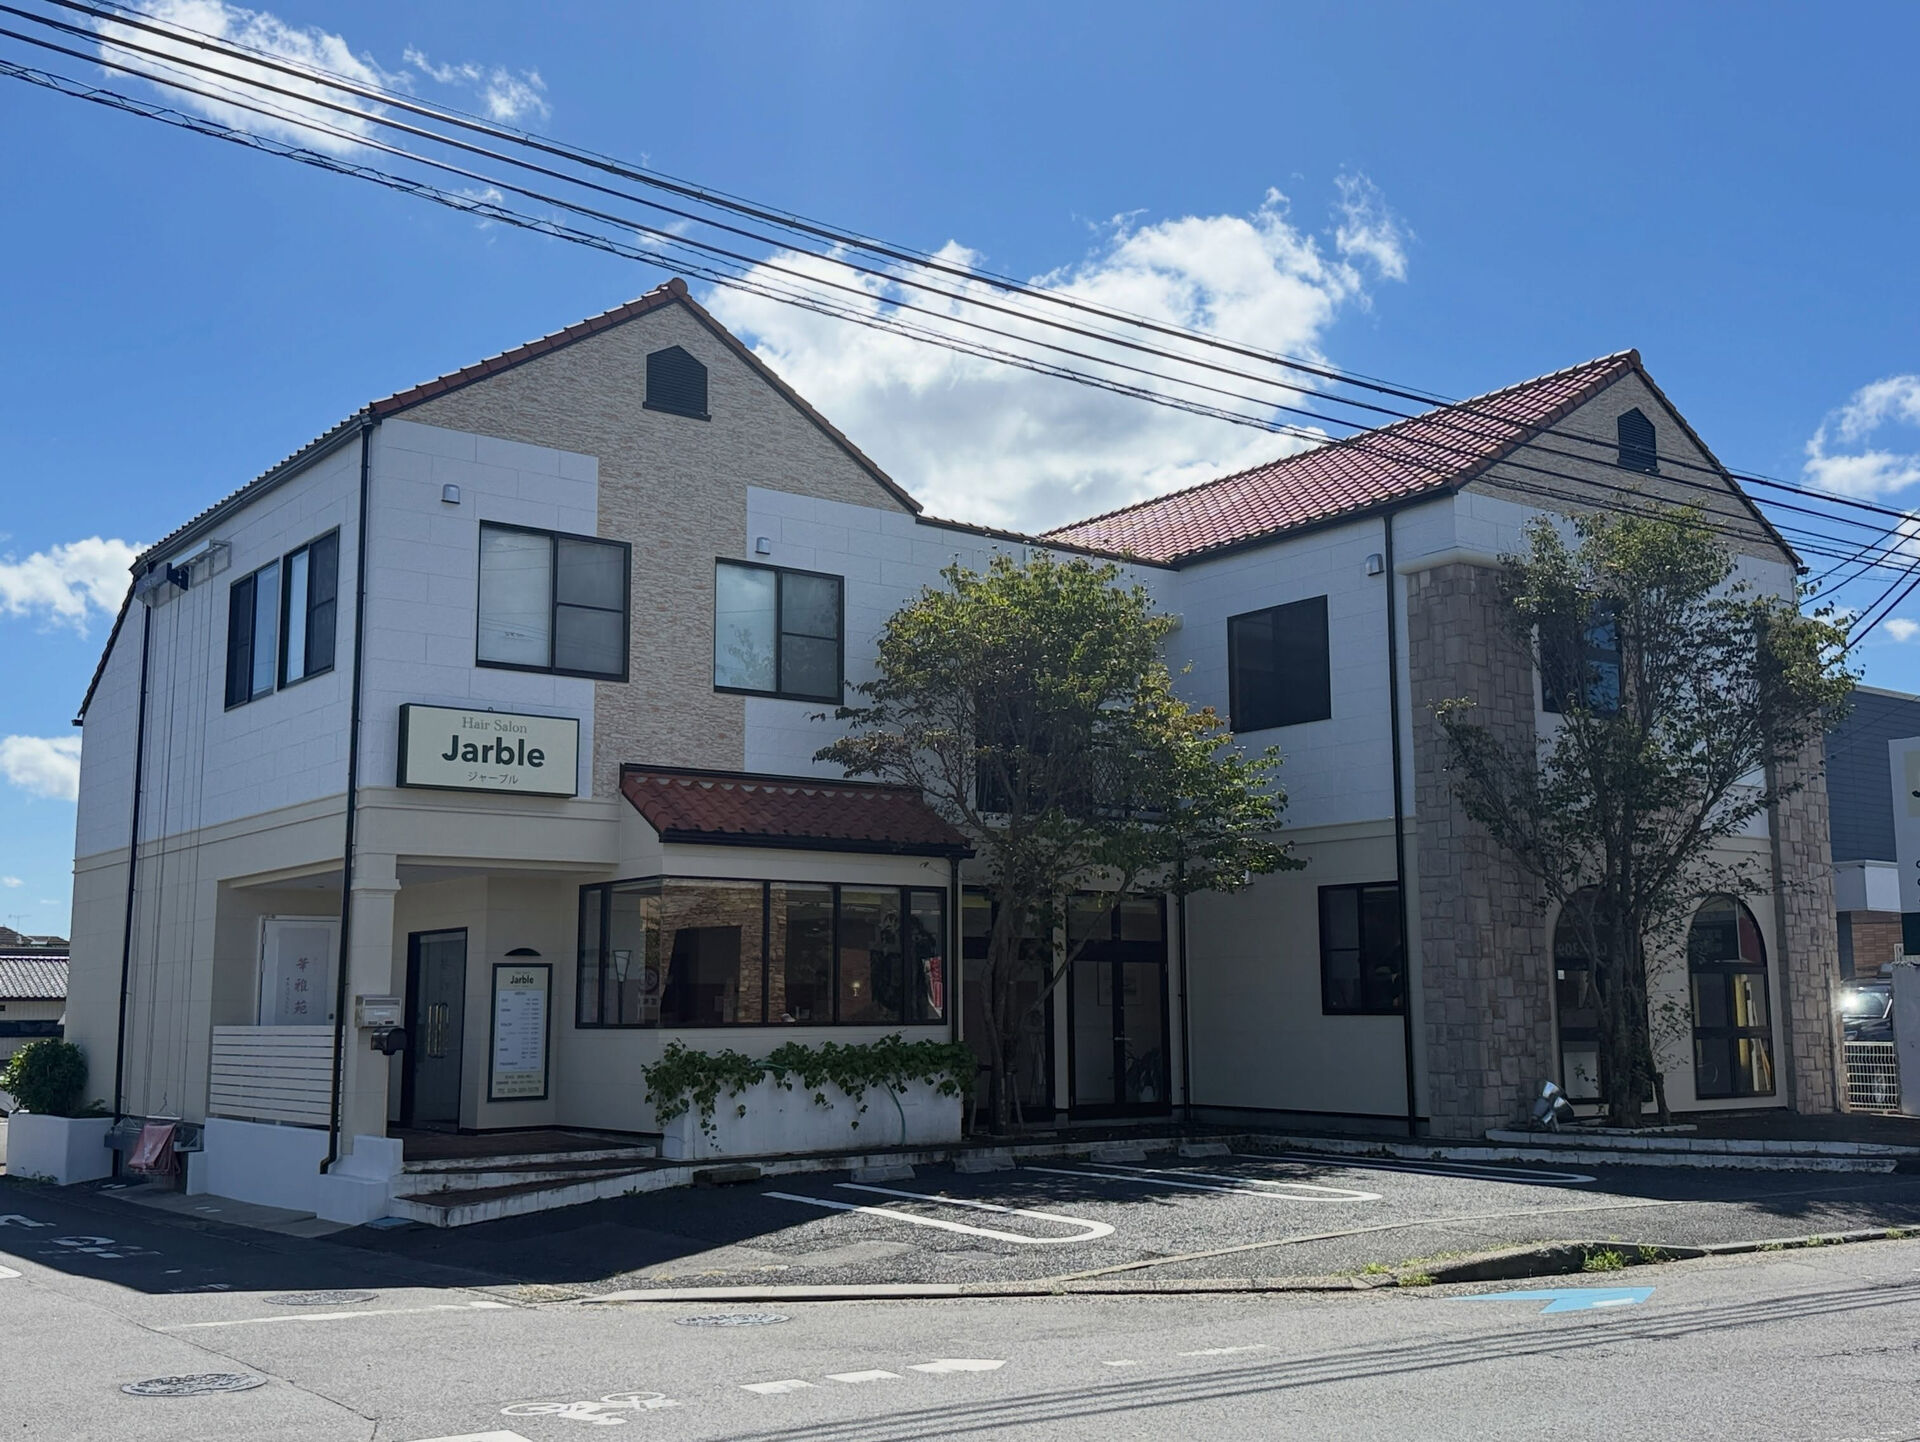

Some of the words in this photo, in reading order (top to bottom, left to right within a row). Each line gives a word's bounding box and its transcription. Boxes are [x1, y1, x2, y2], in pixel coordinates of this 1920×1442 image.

[462, 716, 490, 731] Hair
[494, 719, 528, 734] Salon
[442, 734, 545, 768] Jarble
[467, 771, 518, 785] ジャーブル
